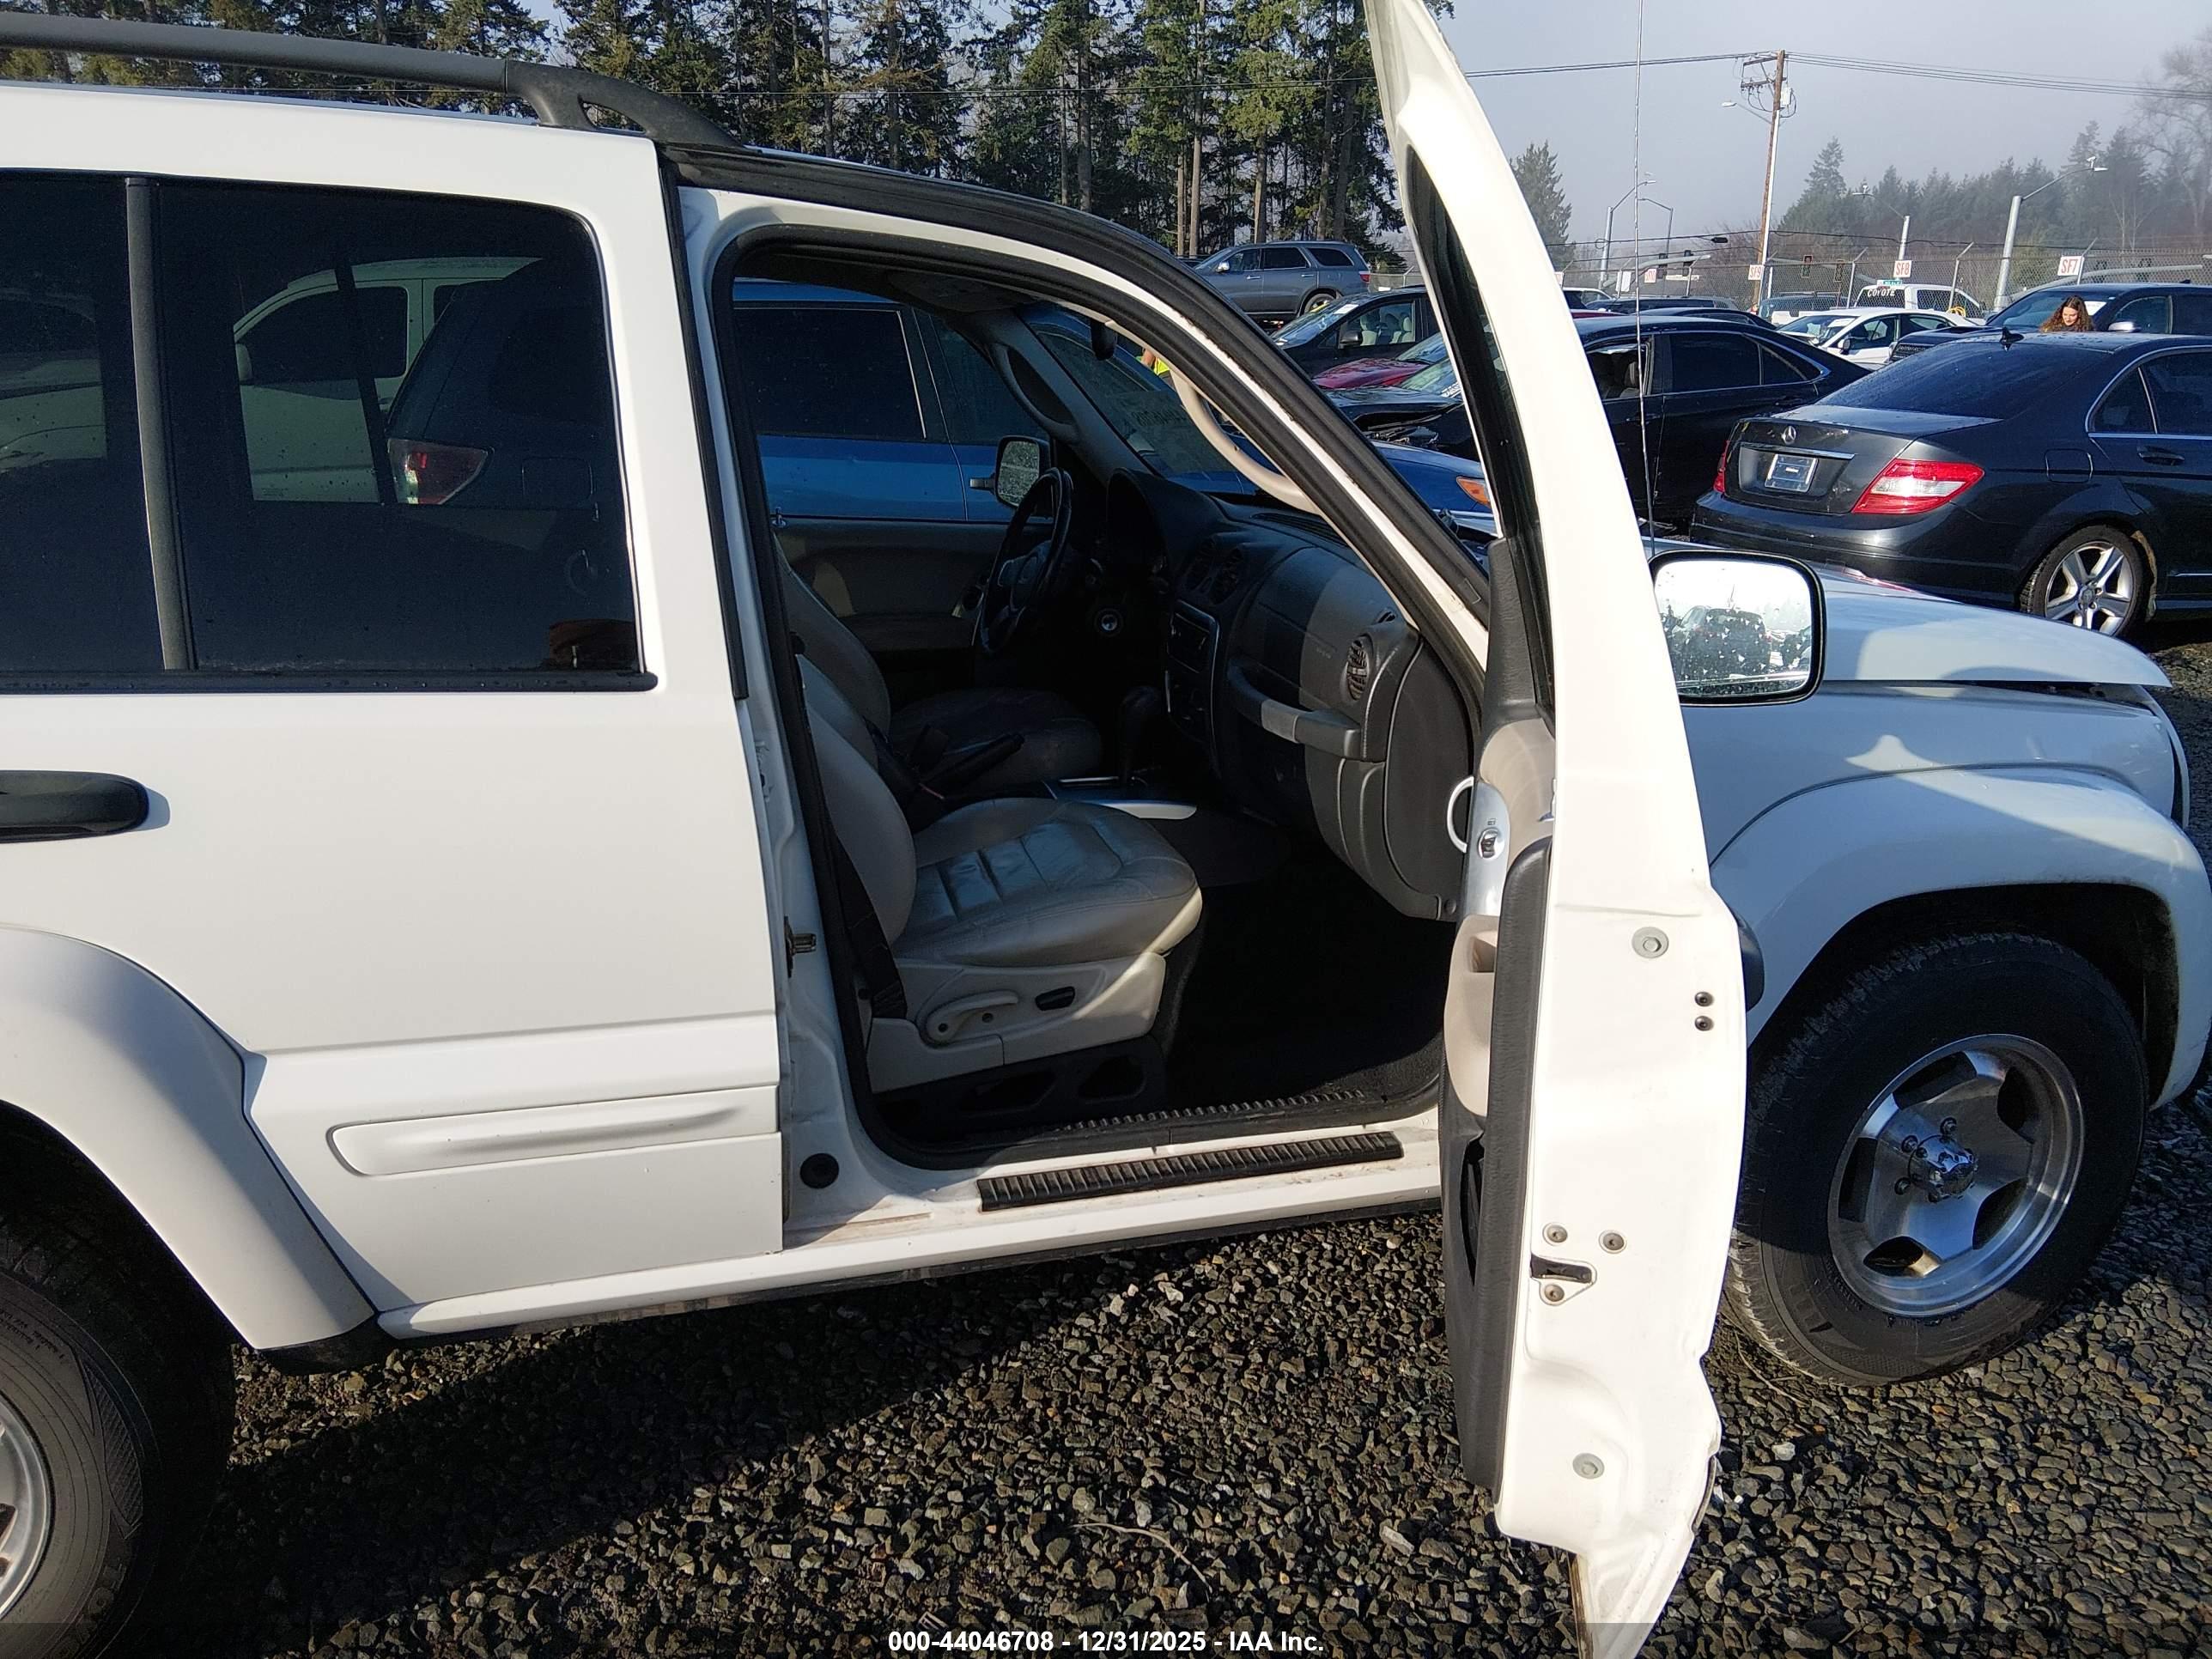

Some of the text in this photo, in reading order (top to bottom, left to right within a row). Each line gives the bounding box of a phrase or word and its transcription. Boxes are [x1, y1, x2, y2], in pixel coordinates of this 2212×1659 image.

[1749, 266, 1762, 278] SF9
[1895, 262, 1910, 276] SF8
[2061, 258, 2078, 274] SF7
[1867, 289, 1896, 297] COYOTE
